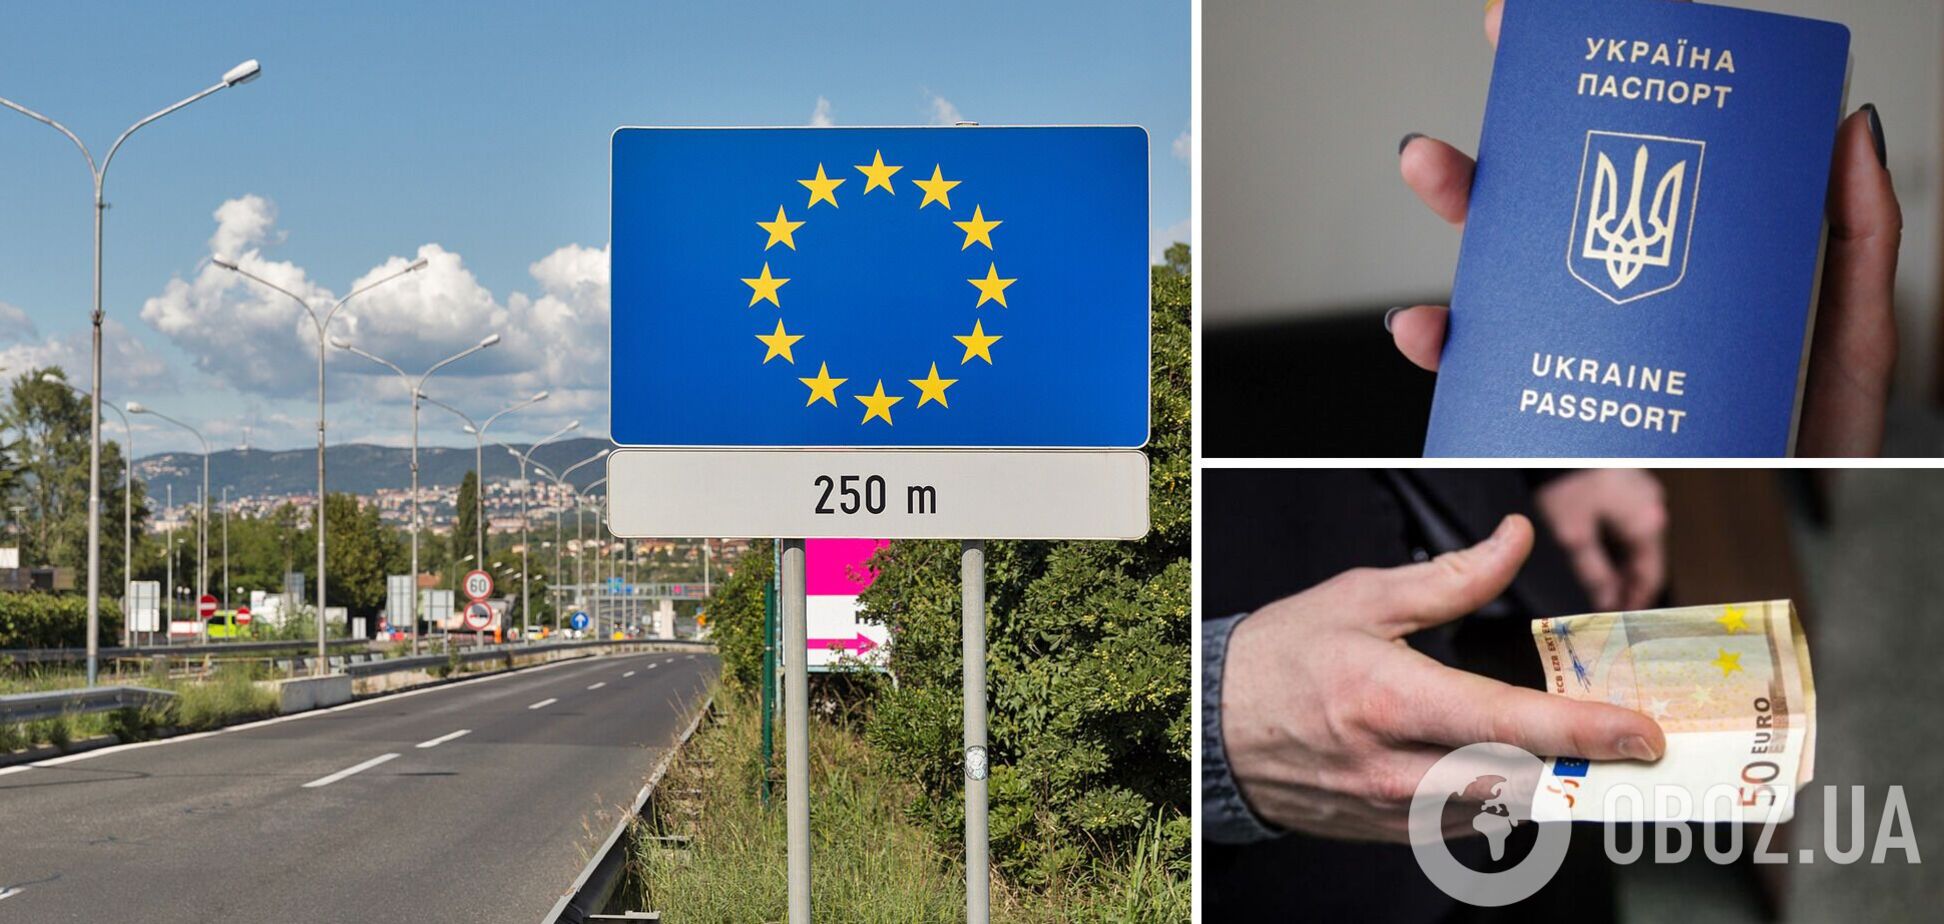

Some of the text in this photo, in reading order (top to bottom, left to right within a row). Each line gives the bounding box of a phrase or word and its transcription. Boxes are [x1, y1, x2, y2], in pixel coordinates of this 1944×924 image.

[1585, 37, 1735, 73] УКРАЇНА
[1577, 73, 1733, 109] ПАСПОРТ
[1532, 352, 1687, 396] UKRAINE
[1520, 389, 1687, 434] PASSPORT
[814, 474, 937, 515] 250 m
[470, 578, 487, 593] 60
[1737, 697, 1780, 806] 50 EURO
